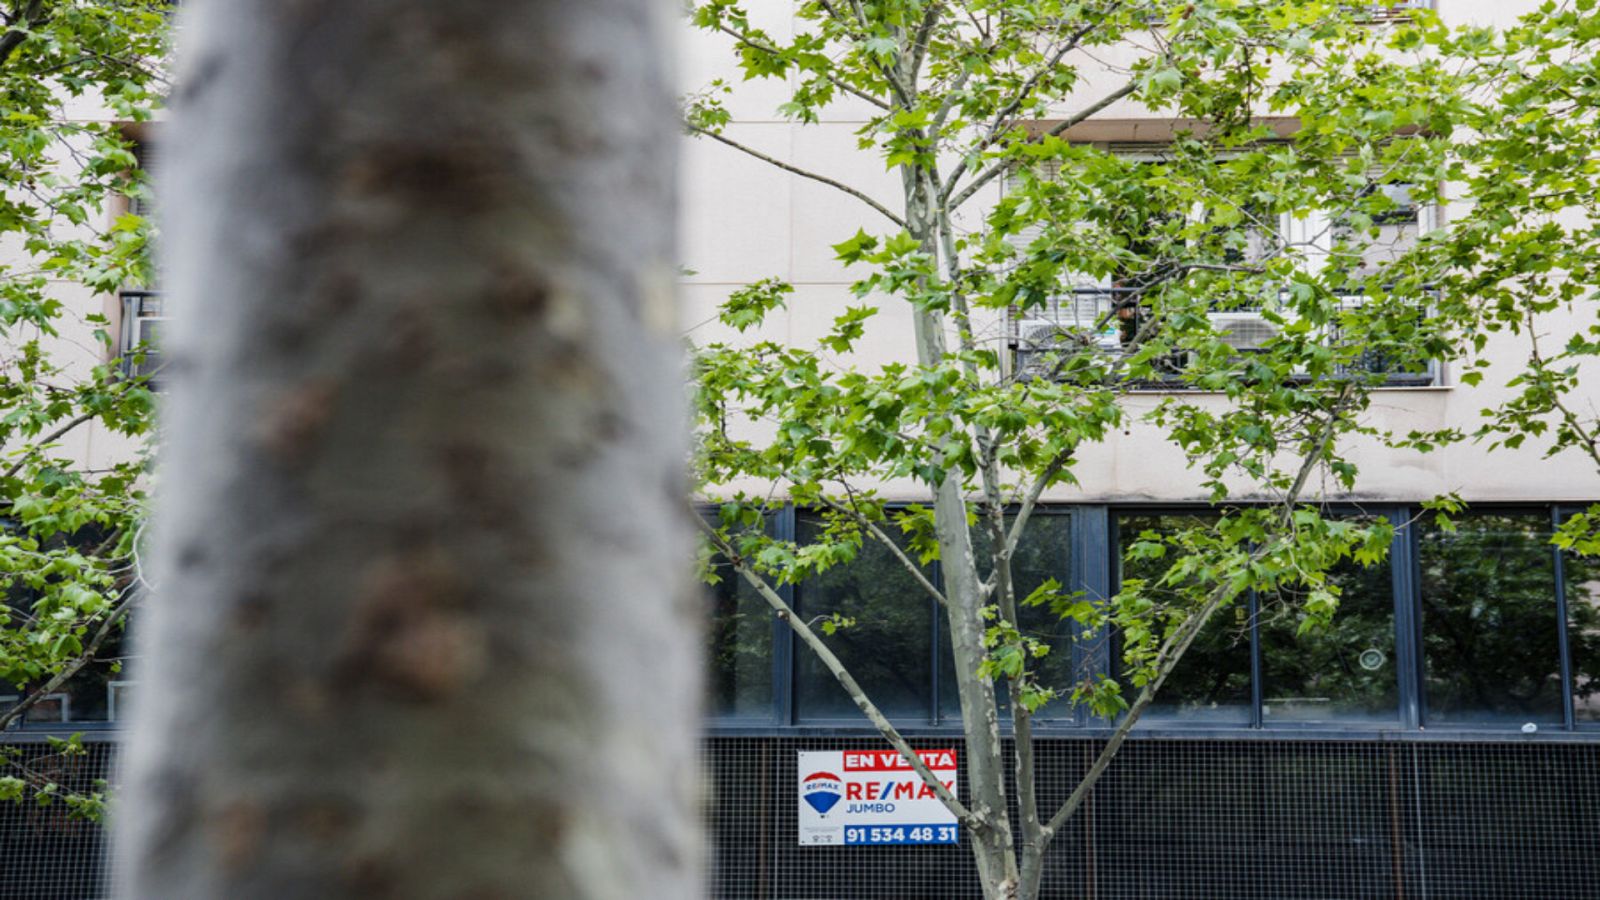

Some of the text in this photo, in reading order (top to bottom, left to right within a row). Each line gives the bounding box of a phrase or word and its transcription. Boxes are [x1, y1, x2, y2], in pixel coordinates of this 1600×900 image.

[845, 754, 875, 768] EN
[846, 803, 896, 814] JUMBO
[847, 828, 865, 842] 91
[871, 828, 905, 841] 534
[910, 827, 933, 841] 48
[938, 827, 956, 841] 31
